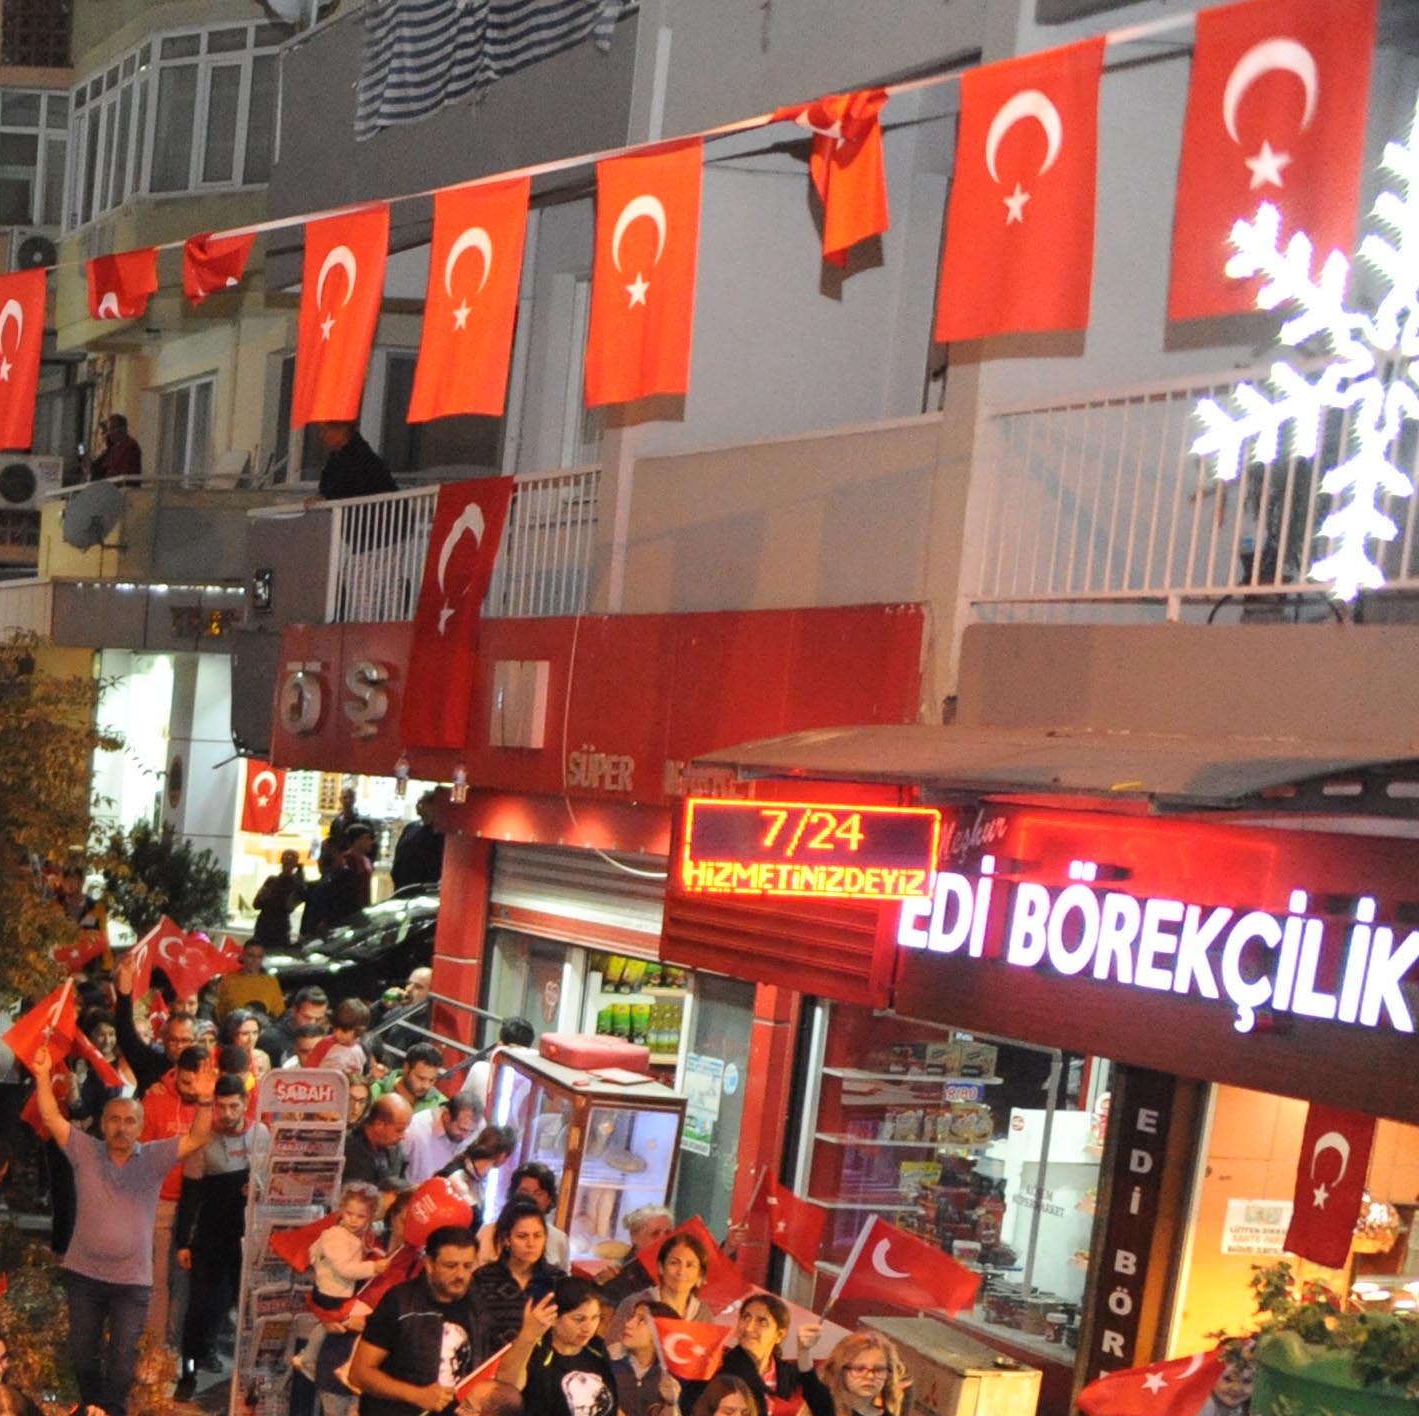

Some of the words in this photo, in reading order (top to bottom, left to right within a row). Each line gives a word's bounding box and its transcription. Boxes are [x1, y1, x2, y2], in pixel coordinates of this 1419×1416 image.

[569, 744, 635, 791] SÜPER
[760, 808, 864, 857] 7/24
[1007, 859, 1419, 1034] BÖREKÇİLİK
[276, 1082, 332, 1101] SABAH
